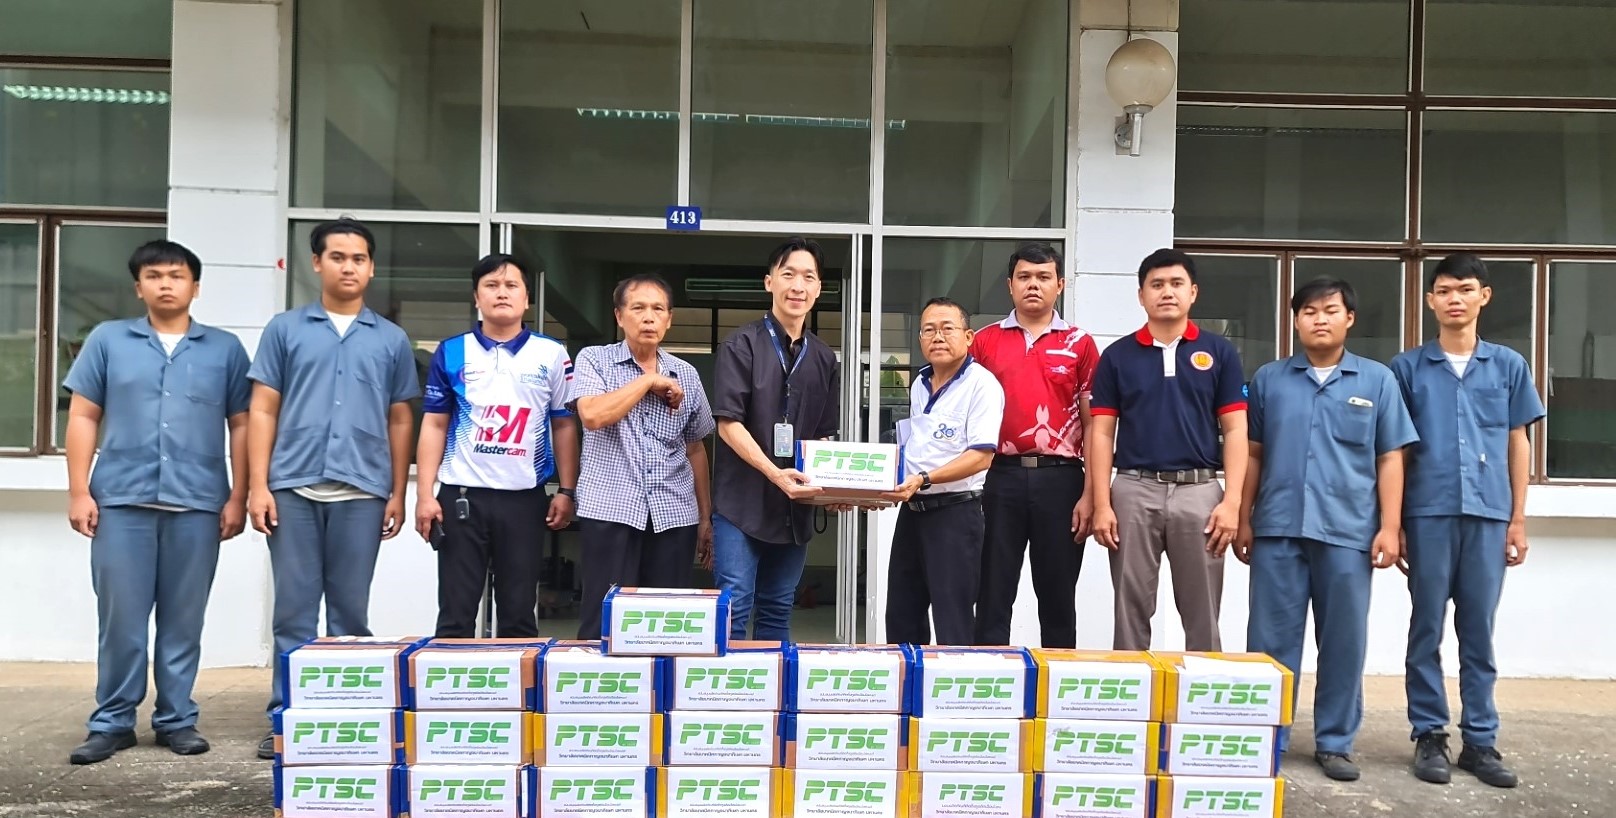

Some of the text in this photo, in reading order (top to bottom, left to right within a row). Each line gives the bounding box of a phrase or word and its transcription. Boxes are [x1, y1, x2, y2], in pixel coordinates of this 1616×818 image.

[670, 210, 696, 225] 413
[473, 444, 527, 457] Mastercam
[812, 450, 886, 472] PTSC
[621, 611, 705, 633] PTSC
[299, 666, 384, 688] PTSC
[425, 667, 509, 688] PTSC
[555, 672, 641, 693] PTSC
[684, 668, 767, 689] PTSC
[807, 669, 889, 690] PTSC
[932, 678, 1014, 698] PTSC
[1058, 679, 1140, 699] PTSC
[1187, 683, 1270, 704] PTSC
[293, 722, 380, 743] PTSC
[426, 721, 511, 743] PTSC
[555, 725, 639, 747] PTSC
[680, 724, 763, 745] PTSC
[805, 728, 887, 749] PTSC
[927, 732, 1009, 752] PTSC
[1054, 732, 1135, 753] PTSC
[1179, 735, 1261, 756] PTSC
[292, 777, 376, 799] PTSC
[419, 780, 505, 800] PTSC
[550, 779, 634, 800] PTSC
[676, 780, 759, 800] PTSC
[803, 781, 885, 802] PTSC
[939, 784, 1004, 801] PTSC
[1052, 786, 1135, 808] PTSC
[1184, 791, 1261, 810] PTSC
